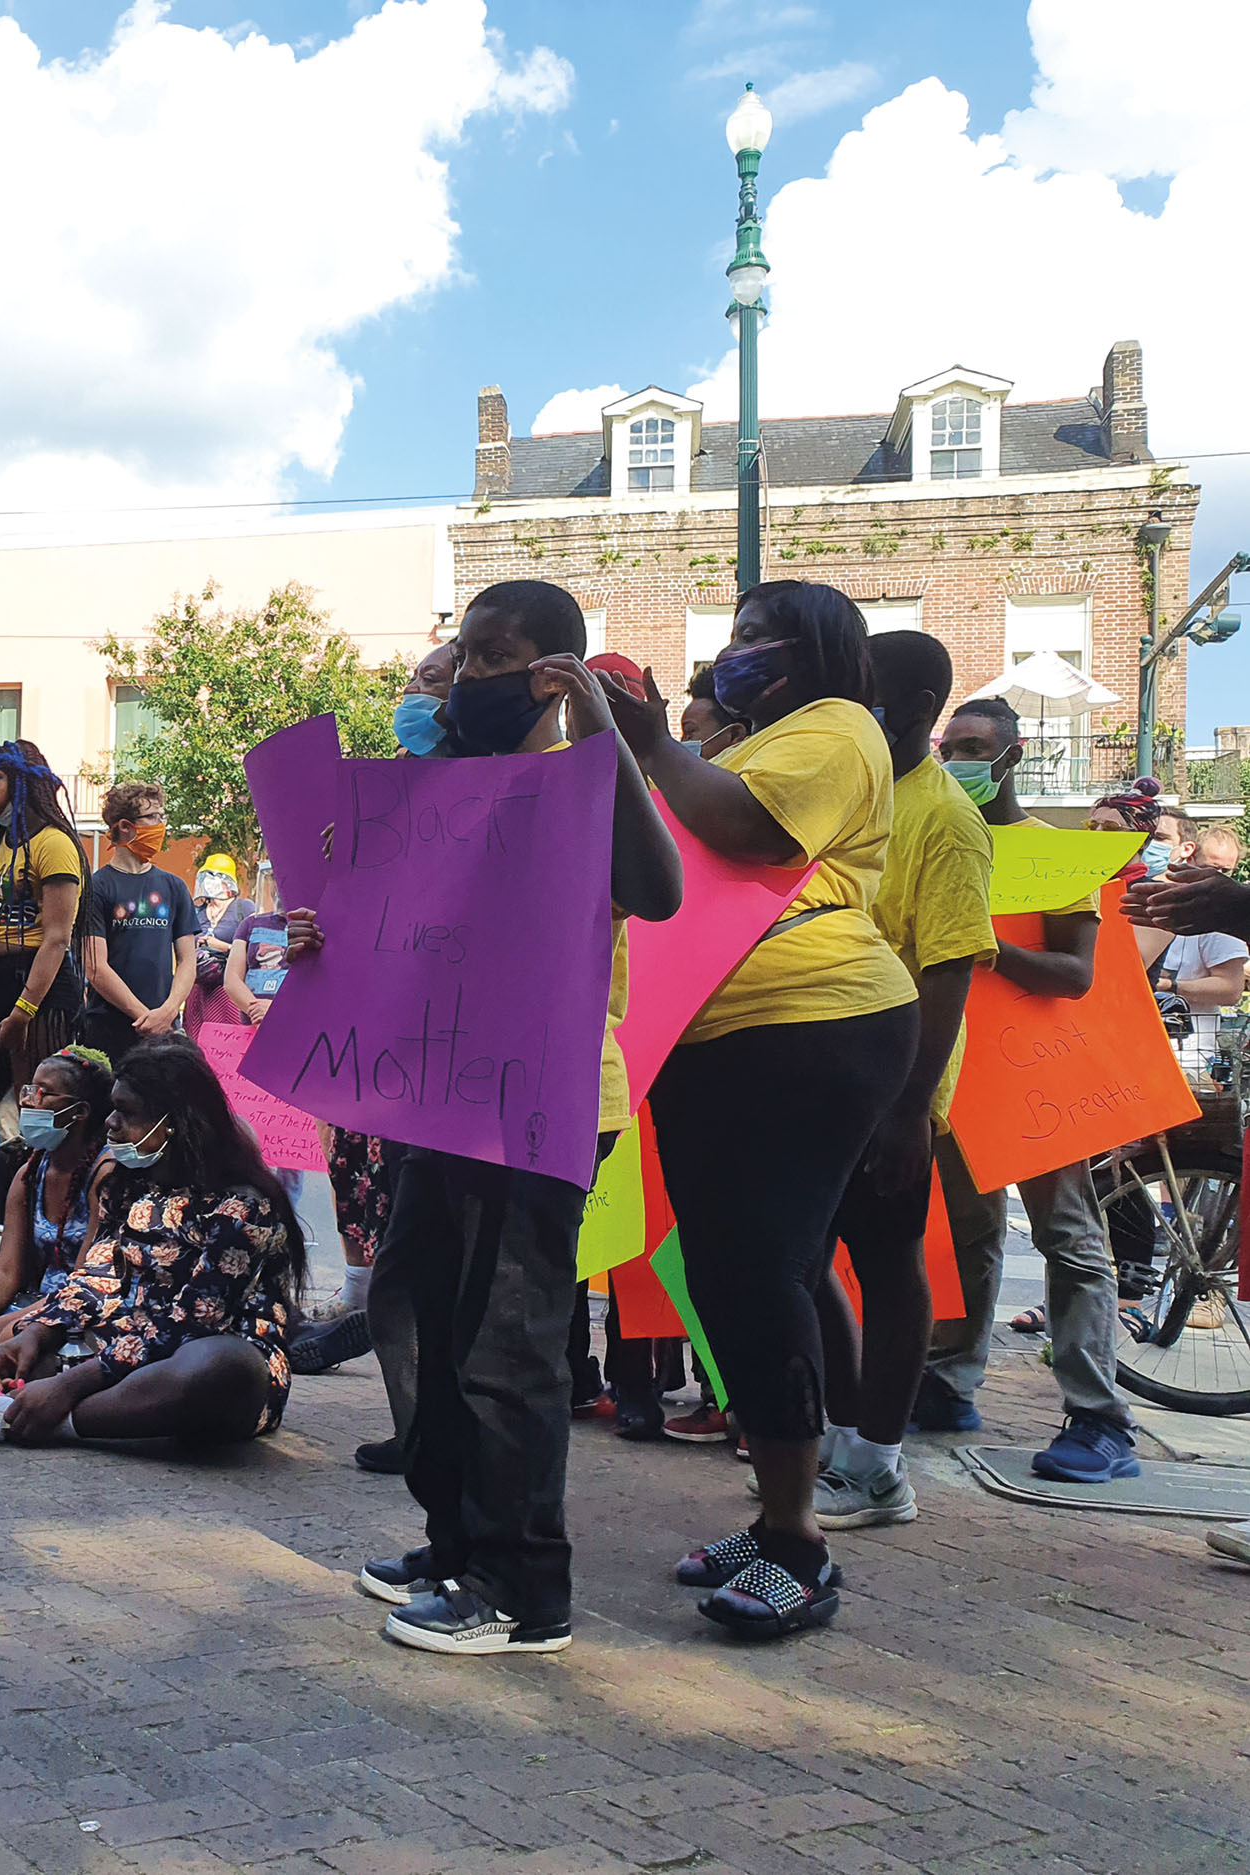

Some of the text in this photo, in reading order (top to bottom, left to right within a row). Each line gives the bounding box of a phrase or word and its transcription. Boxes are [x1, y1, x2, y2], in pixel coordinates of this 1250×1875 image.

[351, 767, 540, 872] Black
[1012, 857, 1114, 880] Justice
[374, 896, 473, 964] Lives
[291, 983, 548, 1150] Matter!
[1000, 1021, 1087, 1068] Can't
[1022, 1081, 1147, 1139] Breathe
